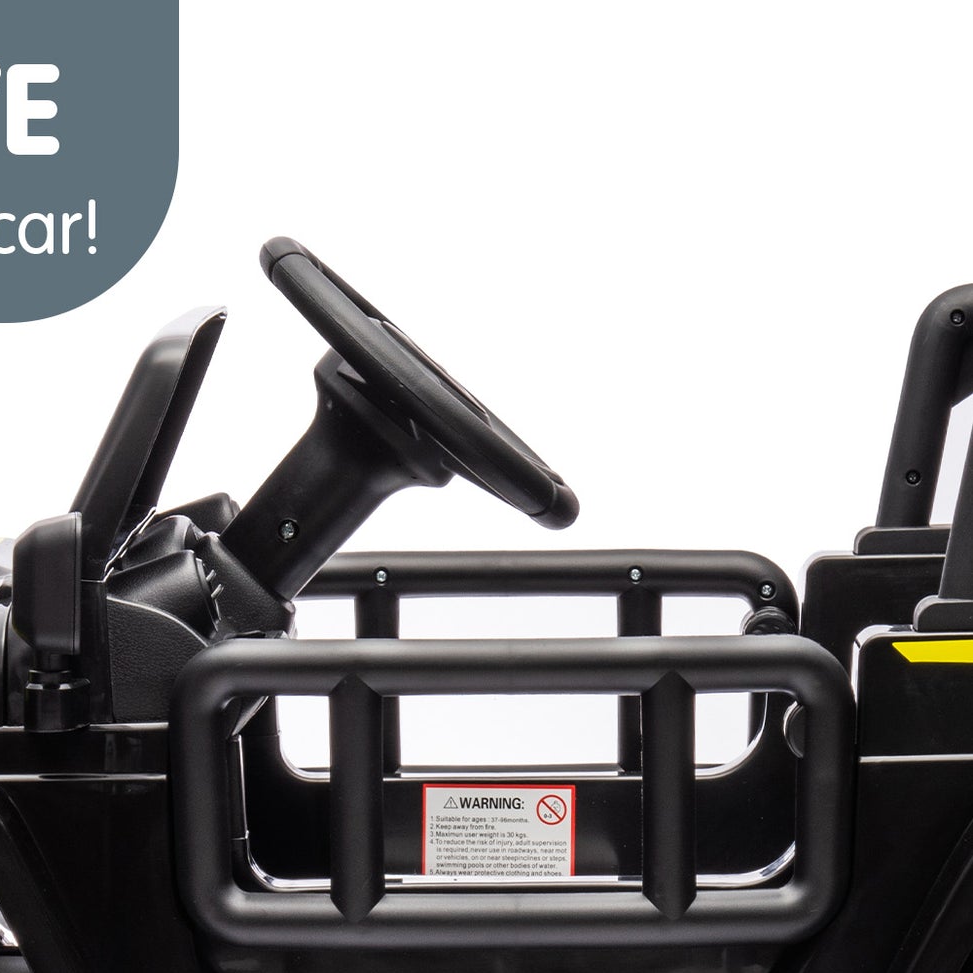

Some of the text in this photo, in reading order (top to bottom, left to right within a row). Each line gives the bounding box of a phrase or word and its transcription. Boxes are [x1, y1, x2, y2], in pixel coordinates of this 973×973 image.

[459, 797, 525, 810] WARNING:
[462, 815, 471, 823] for
[479, 831, 499, 839] weight
